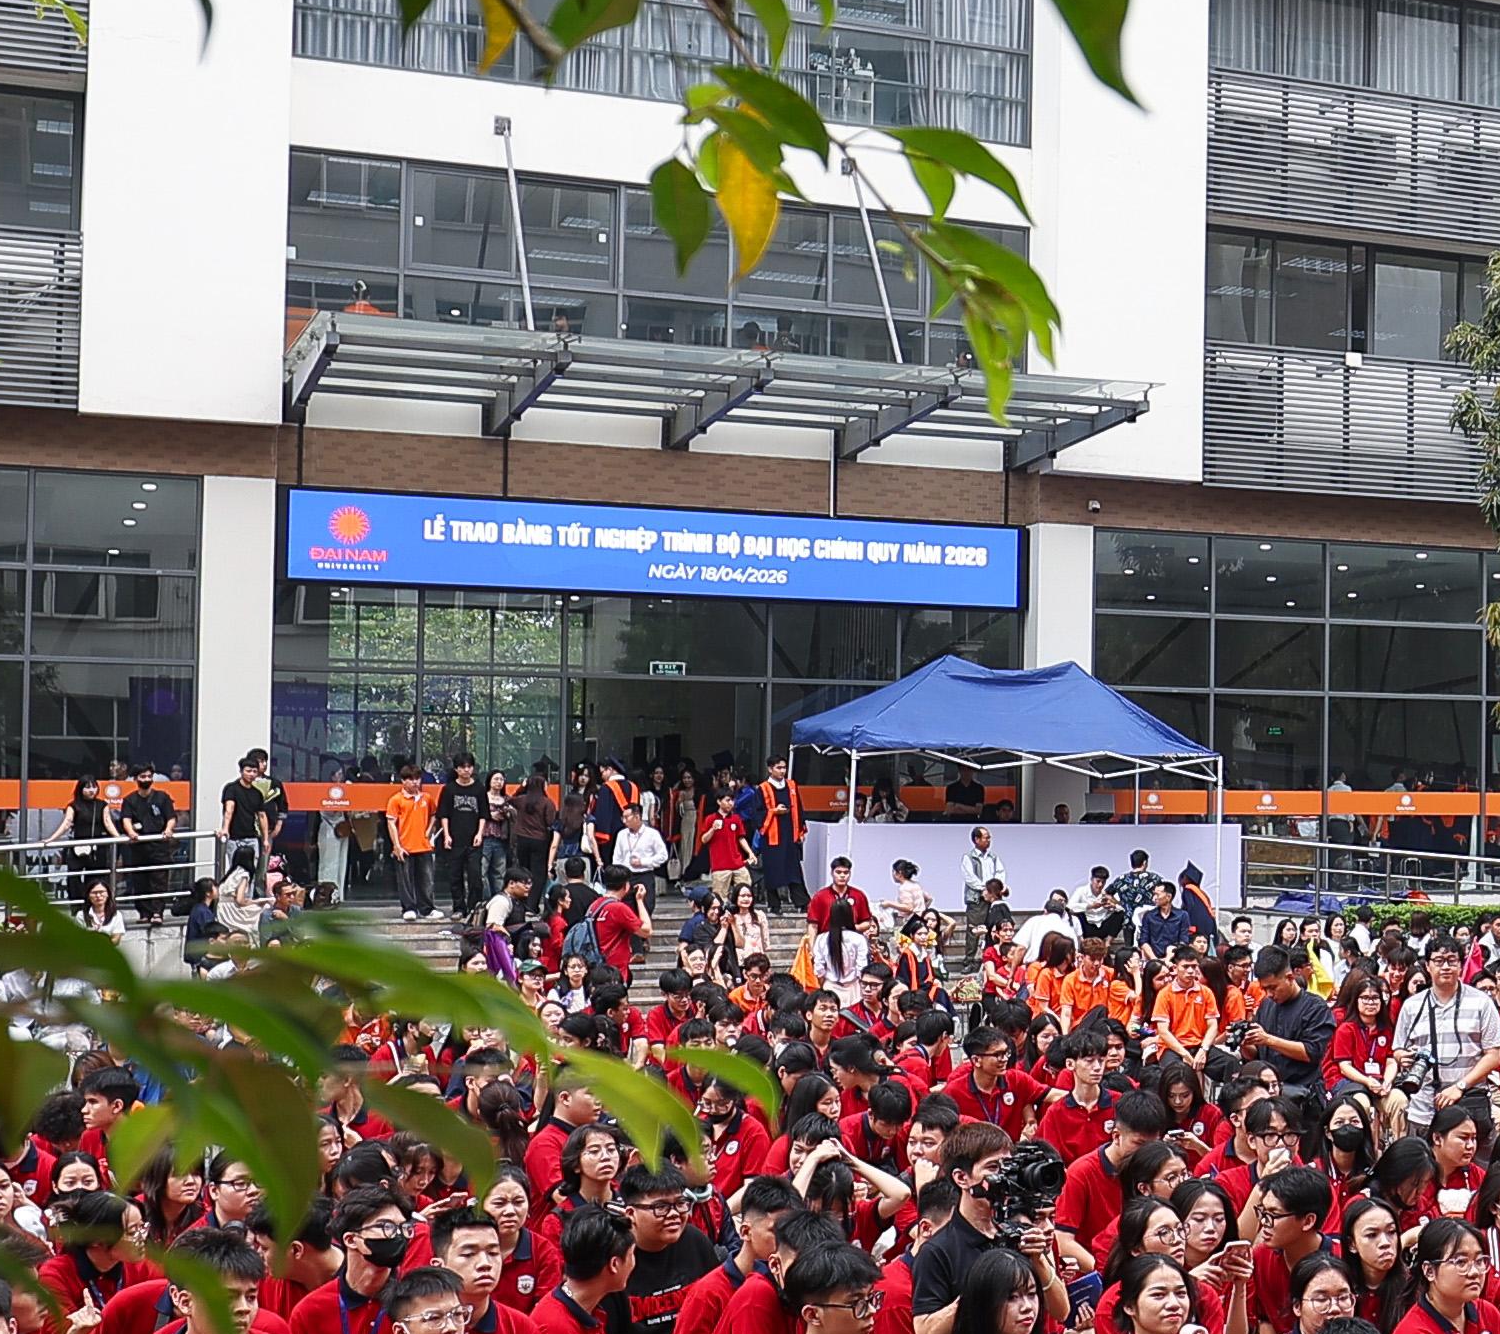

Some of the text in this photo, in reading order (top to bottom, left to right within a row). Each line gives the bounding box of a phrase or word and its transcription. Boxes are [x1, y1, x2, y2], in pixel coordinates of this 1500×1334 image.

[450, 519, 498, 543] TRAO
[557, 520, 591, 548] TỐT
[595, 524, 657, 554] NGHIỆP
[661, 527, 713, 554] TRÌNH
[716, 531, 740, 559] ĐỘ
[743, 534, 773, 560] ĐẠI
[776, 537, 811, 562] HỌC
[814, 535, 864, 561] CHÍNH
[867, 541, 900, 564] QUY
[903, 542, 942, 565] NĂM
[944, 546, 988, 567] 2026
[345, 548, 389, 563] NAM
[648, 561, 788, 585] NGÀY 18/04/2026
